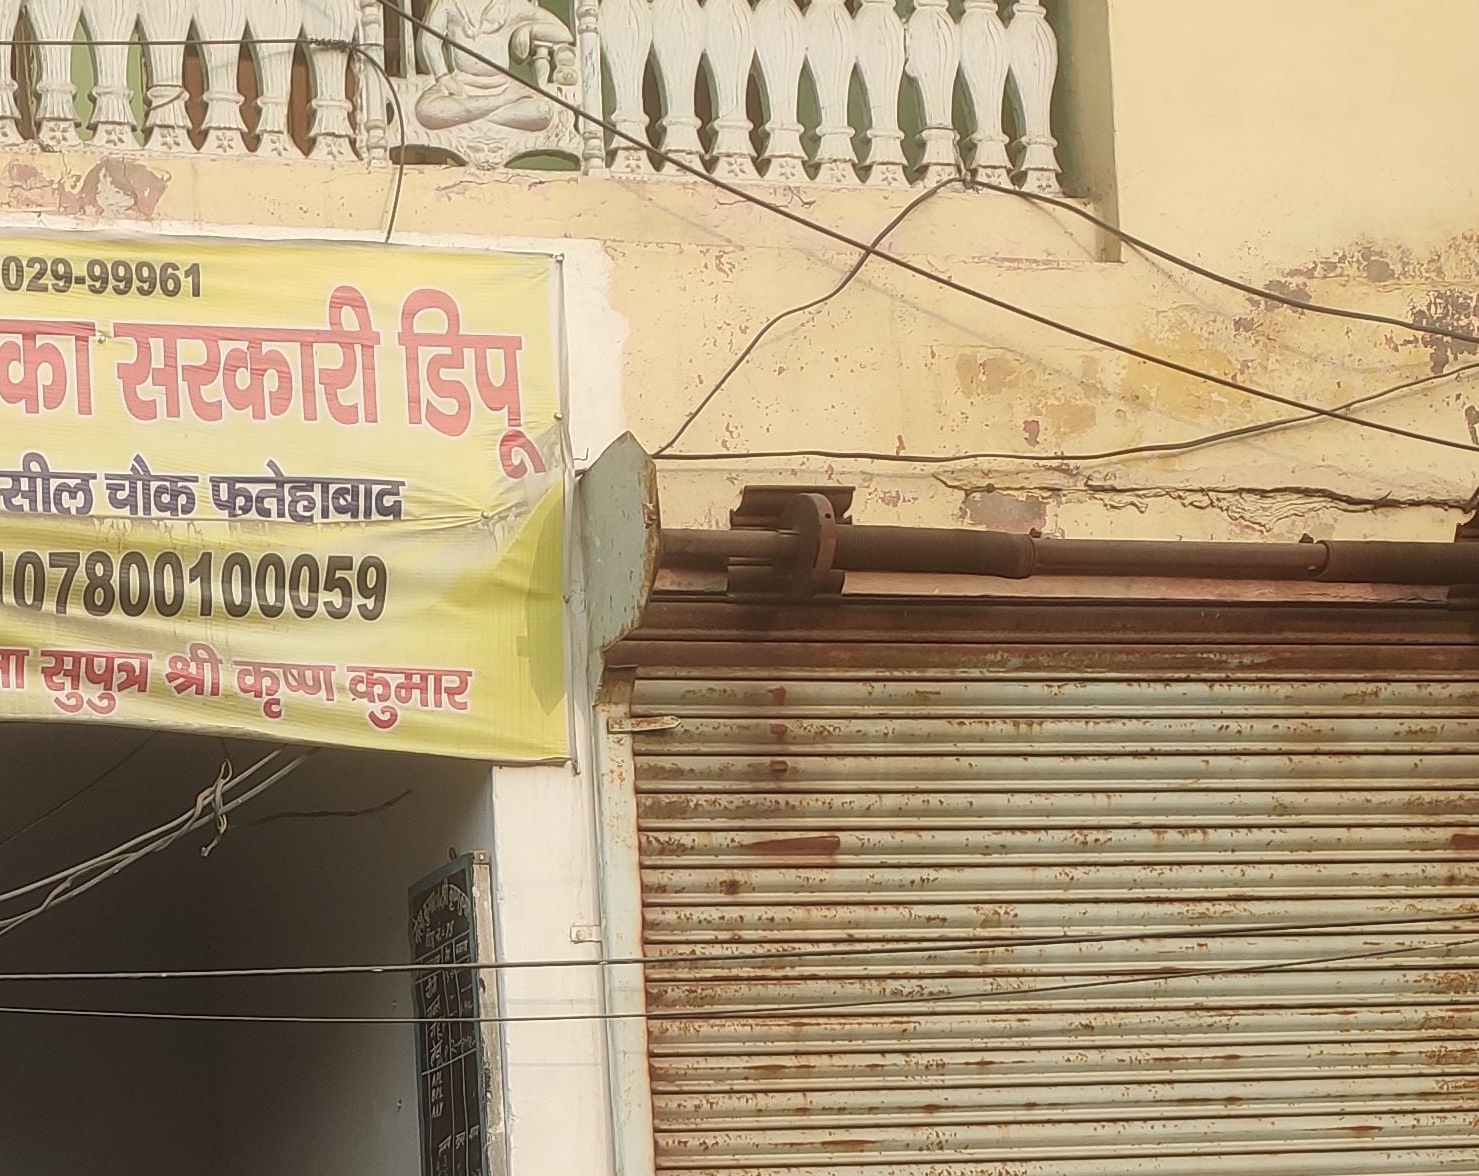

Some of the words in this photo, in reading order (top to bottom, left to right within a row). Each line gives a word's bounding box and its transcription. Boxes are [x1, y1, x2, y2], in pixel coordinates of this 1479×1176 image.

[113, 285, 381, 425] सरकारी
[398, 287, 547, 480] डिपू
[104, 453, 200, 518] चौक
[209, 459, 407, 524] फतेहाबाद
[40, 649, 153, 715] सुपुत्र
[164, 642, 222, 697] श्री
[233, 659, 336, 719] कृष्ण
[346, 665, 474, 730] कुमार
